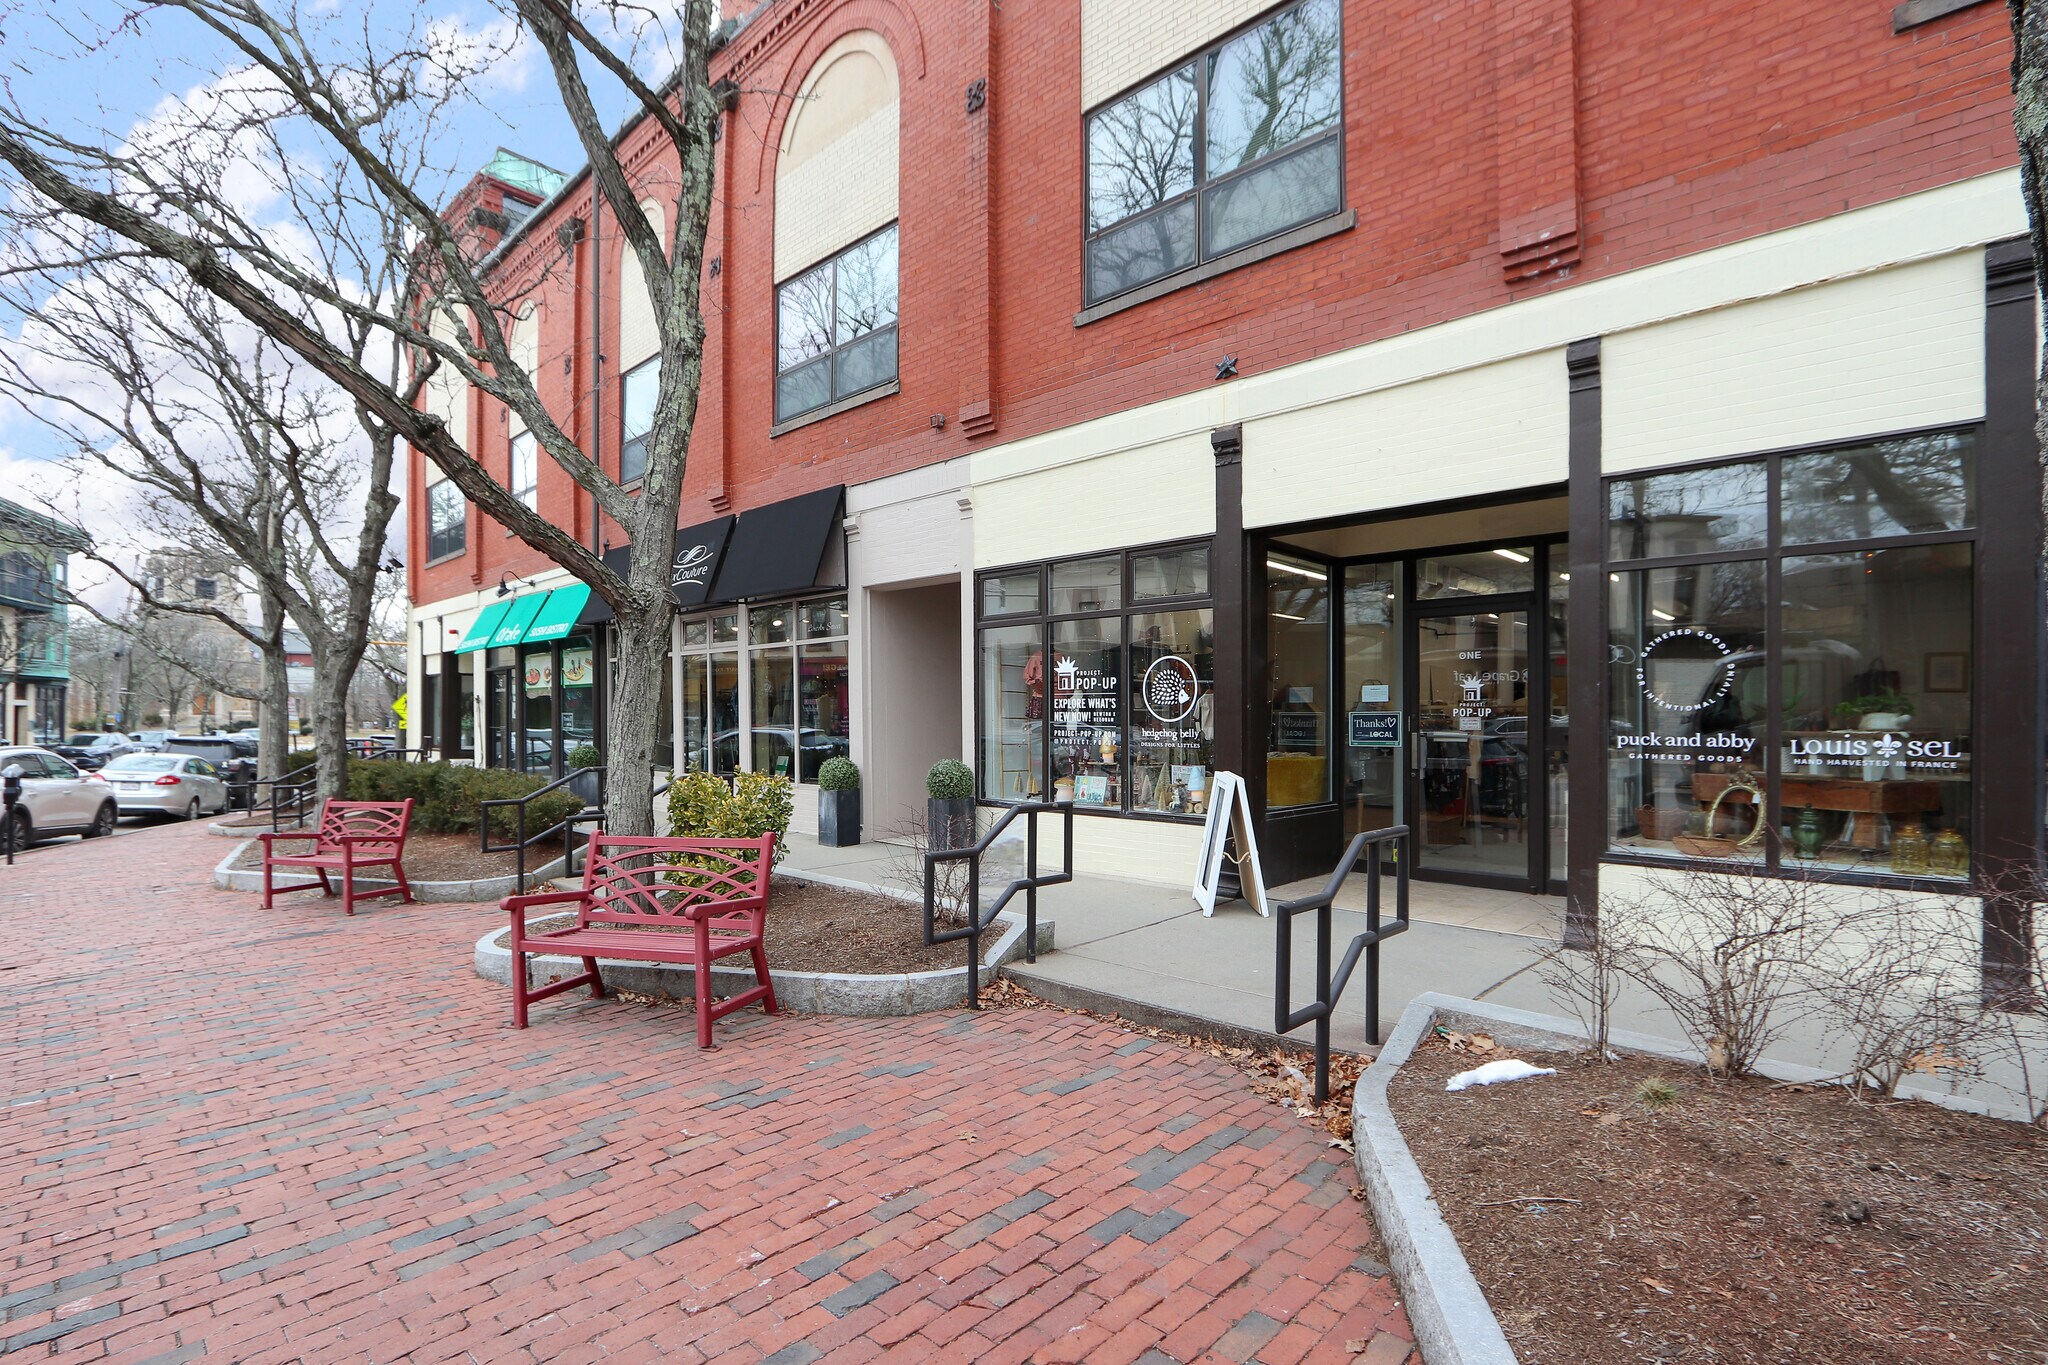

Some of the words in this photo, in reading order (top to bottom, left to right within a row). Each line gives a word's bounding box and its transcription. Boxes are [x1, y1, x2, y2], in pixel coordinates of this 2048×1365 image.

[1641, 628, 1692, 658] GATHERED
[1697, 630, 1731, 655] GOODS
[1459, 651, 1481, 659] ONE
[1076, 677, 1117, 689] POP-UP
[1636, 667, 1646, 687] FOR
[1716, 663, 1736, 697] LIVING
[1054, 698, 1086, 709] EXPLORE
[1088, 698, 1117, 709] WHAT'S
[1643, 689, 1716, 711] INTENTIONAL
[1054, 712, 1068, 721] NEW
[1069, 712, 1091, 722] NOW!
[1452, 708, 1492, 717] POP-UP
[1354, 719, 1388, 728] Thanks!
[1141, 728, 1178, 741] hedgehog
[1180, 728, 1200, 740] belly
[1617, 732, 1662, 748] puck
[1665, 733, 1701, 747] and
[1705, 733, 1756, 752] abby
[1628, 753, 1692, 761] GATHERED
[1698, 755, 1743, 763] GOODS
[1827, 759, 1890, 767] HARVESTED
[1911, 761, 1957, 769] FRANCE
